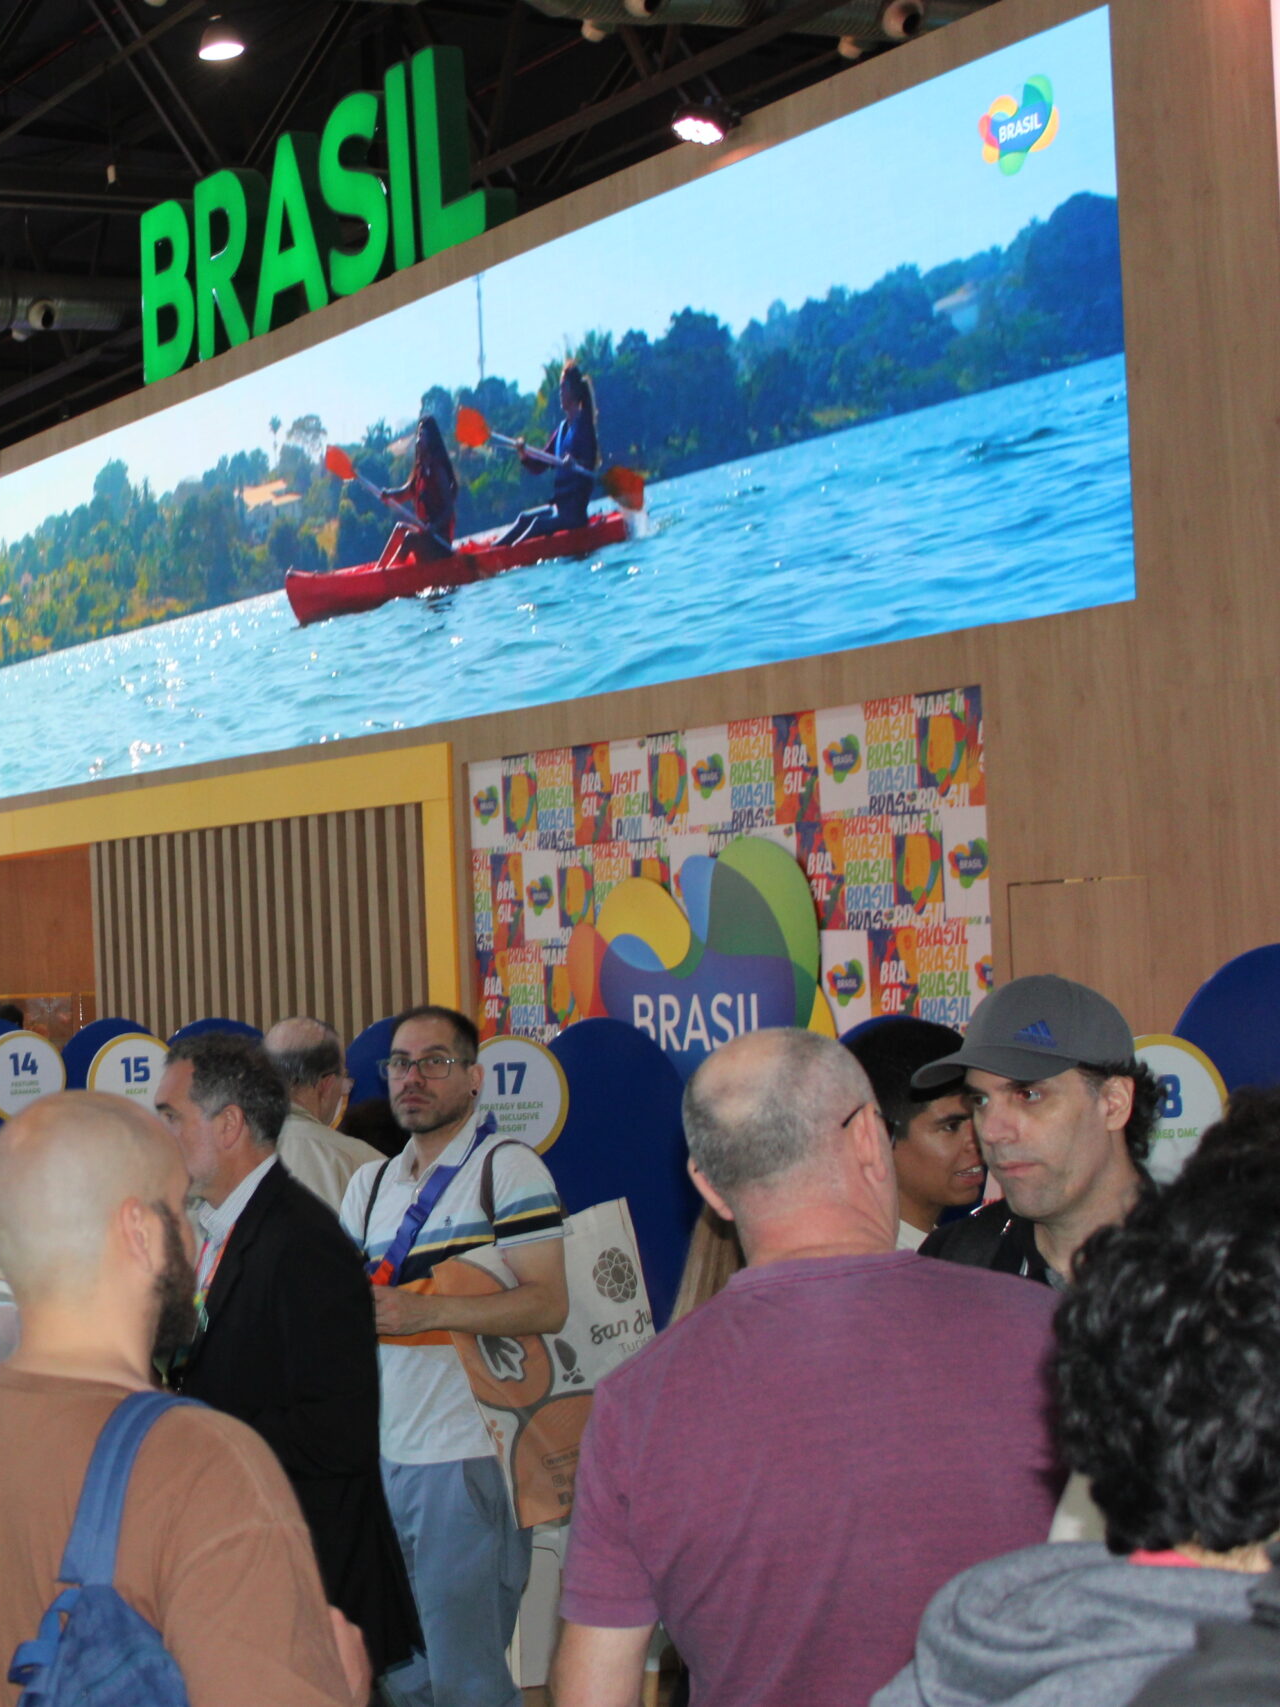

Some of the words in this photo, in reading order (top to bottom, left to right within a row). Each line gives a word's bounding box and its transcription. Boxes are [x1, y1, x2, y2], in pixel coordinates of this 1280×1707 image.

[997, 111, 1043, 145] BRASIL
[140, 45, 488, 387] BRASIL
[782, 744, 808, 769] BRA
[783, 771, 807, 796] SIL
[880, 960, 907, 985] BRA
[919, 970, 971, 999] BRASIL
[881, 988, 906, 1012] SIL
[9, 1052, 39, 1077] 14
[120, 1056, 151, 1083] 15
[125, 1087, 149, 1096] RECIFE
[492, 1062, 528, 1096] 17
[516, 1101, 544, 1110] BEACH
[1156, 1073, 1183, 1118] 8
[499, 1111, 540, 1121] INCLUSIVE
